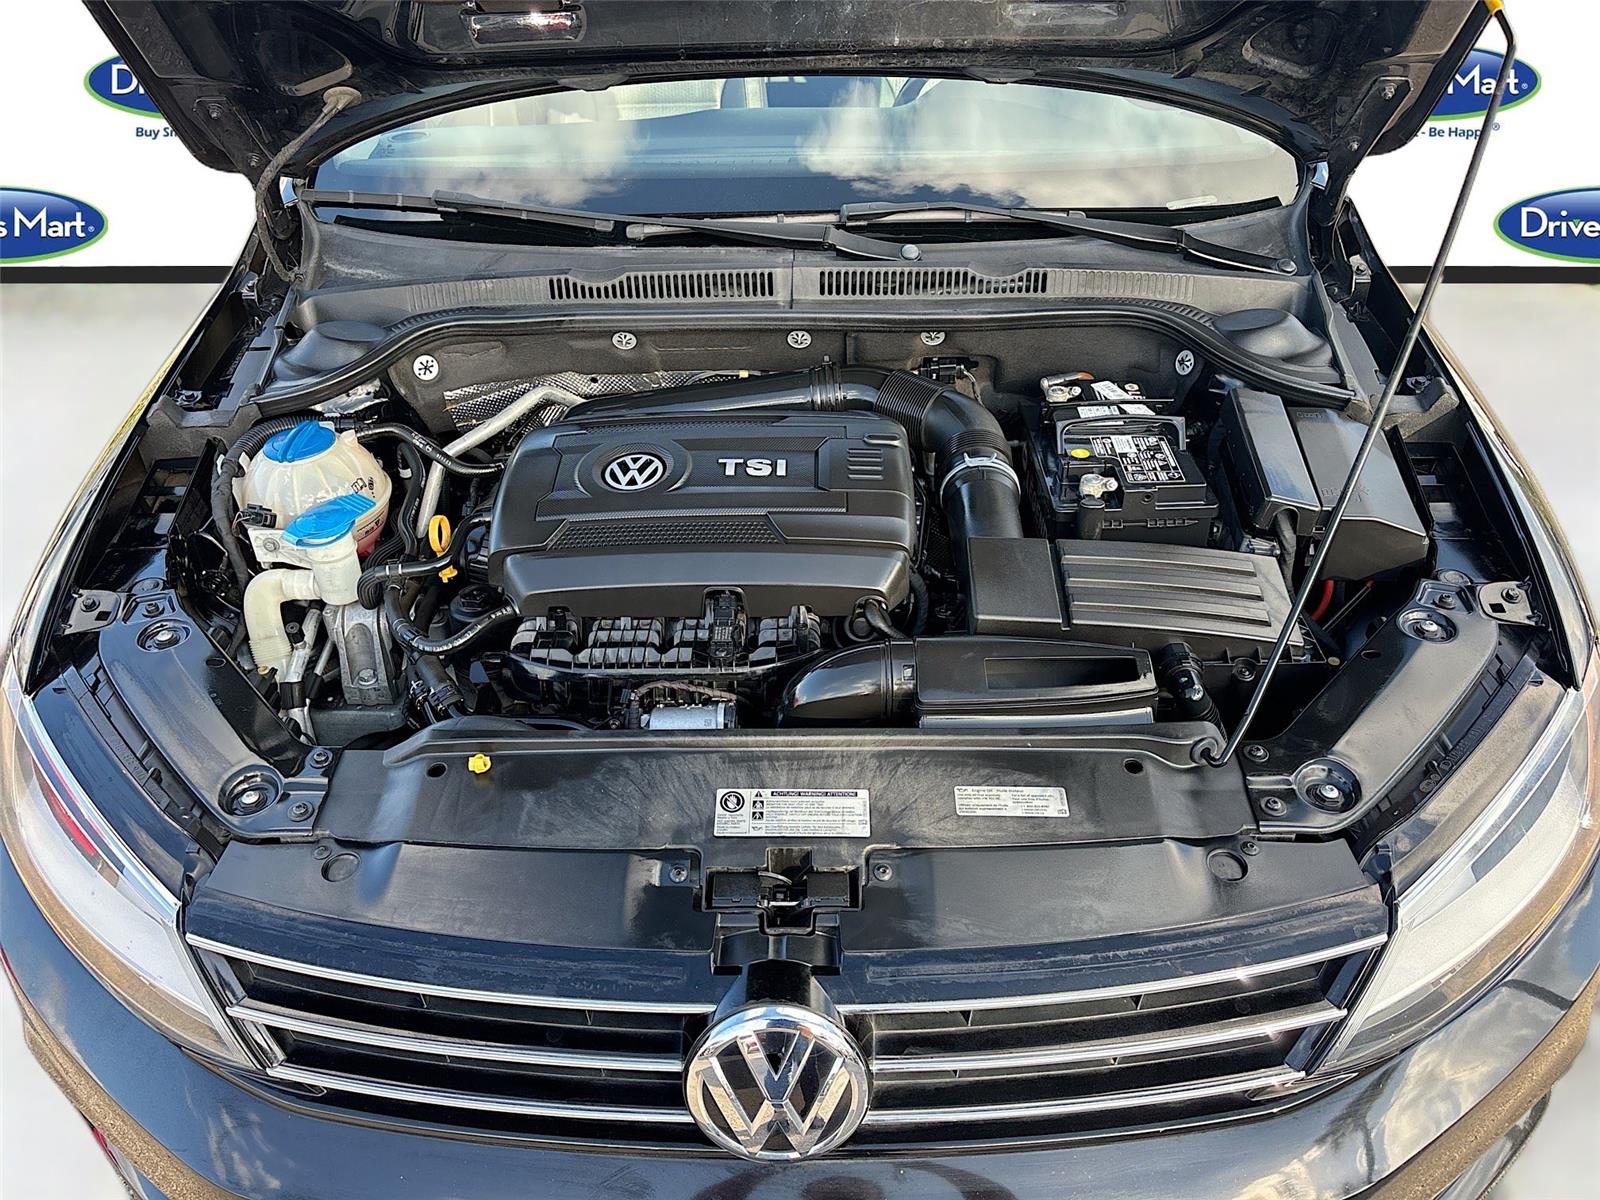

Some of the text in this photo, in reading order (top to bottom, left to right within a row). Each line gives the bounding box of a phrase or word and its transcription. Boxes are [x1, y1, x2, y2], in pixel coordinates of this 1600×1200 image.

[1447, 63, 1520, 95] Mat
[135, 127, 160, 140] Buy
[1429, 127, 1445, 138] Be
[1448, 127, 1482, 140] Happ
[14, 206, 86, 238] Mart
[718, 458, 787, 477] TSI
